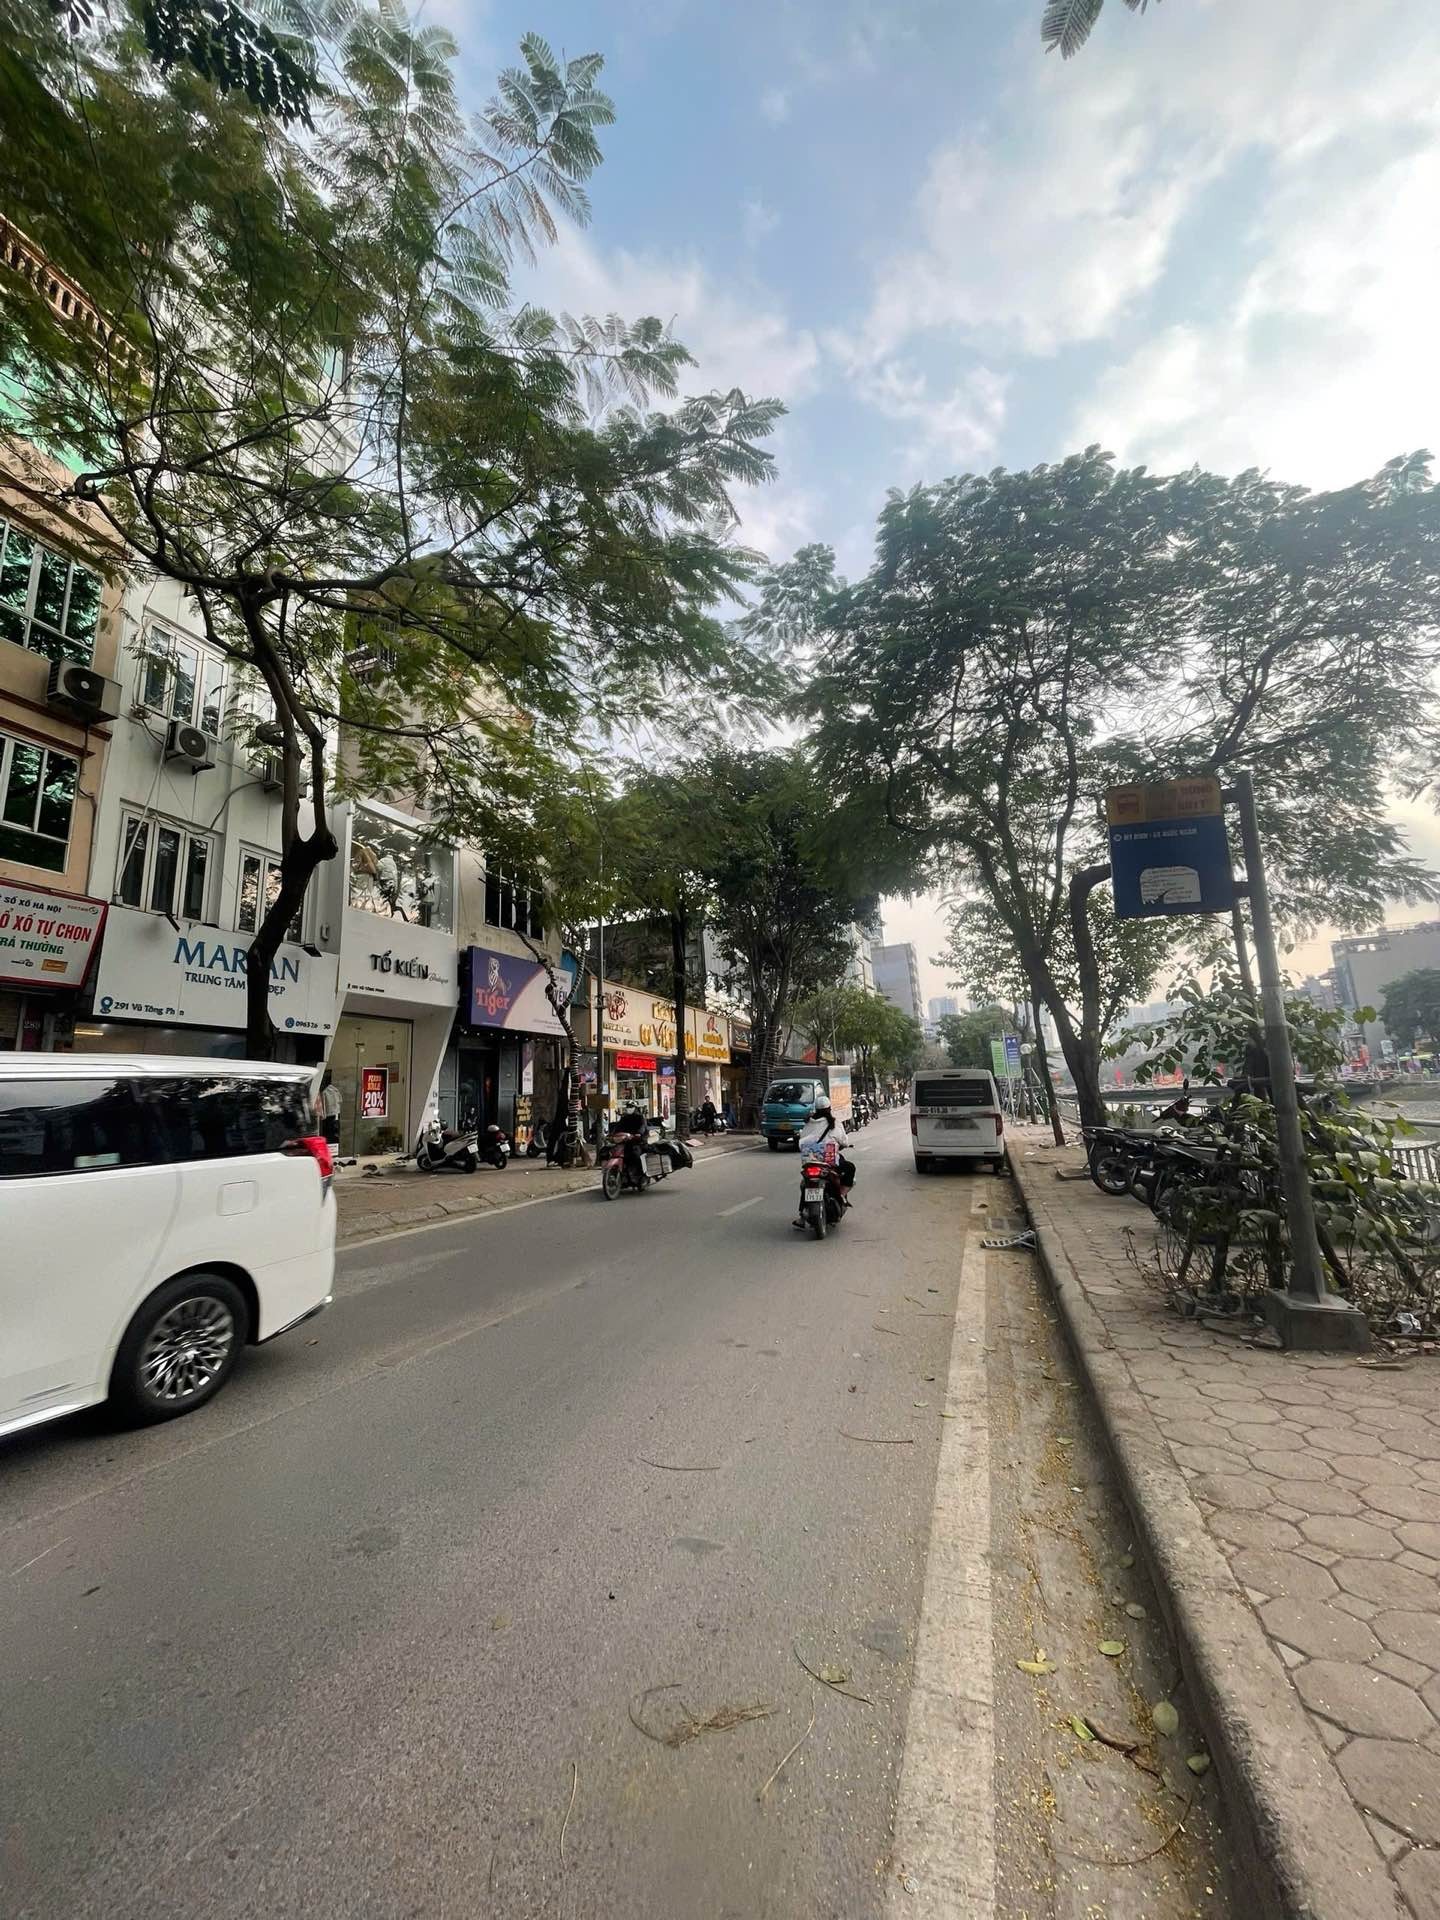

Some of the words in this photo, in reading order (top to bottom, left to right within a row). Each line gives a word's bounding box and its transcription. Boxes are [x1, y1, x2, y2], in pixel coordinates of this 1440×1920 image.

[36, 919, 57, 939] TỰ
[56, 923, 92, 944] CHỌN
[0, 936, 16, 948] RẢ
[20, 940, 64, 955] THƯỞNG
[184, 971, 222, 987] TRUNG
[223, 977, 247, 990] TÂM
[114, 1001, 129, 1010] 291
[475, 987, 511, 1016] Tiger
[364, 1091, 384, 1108] 20%
